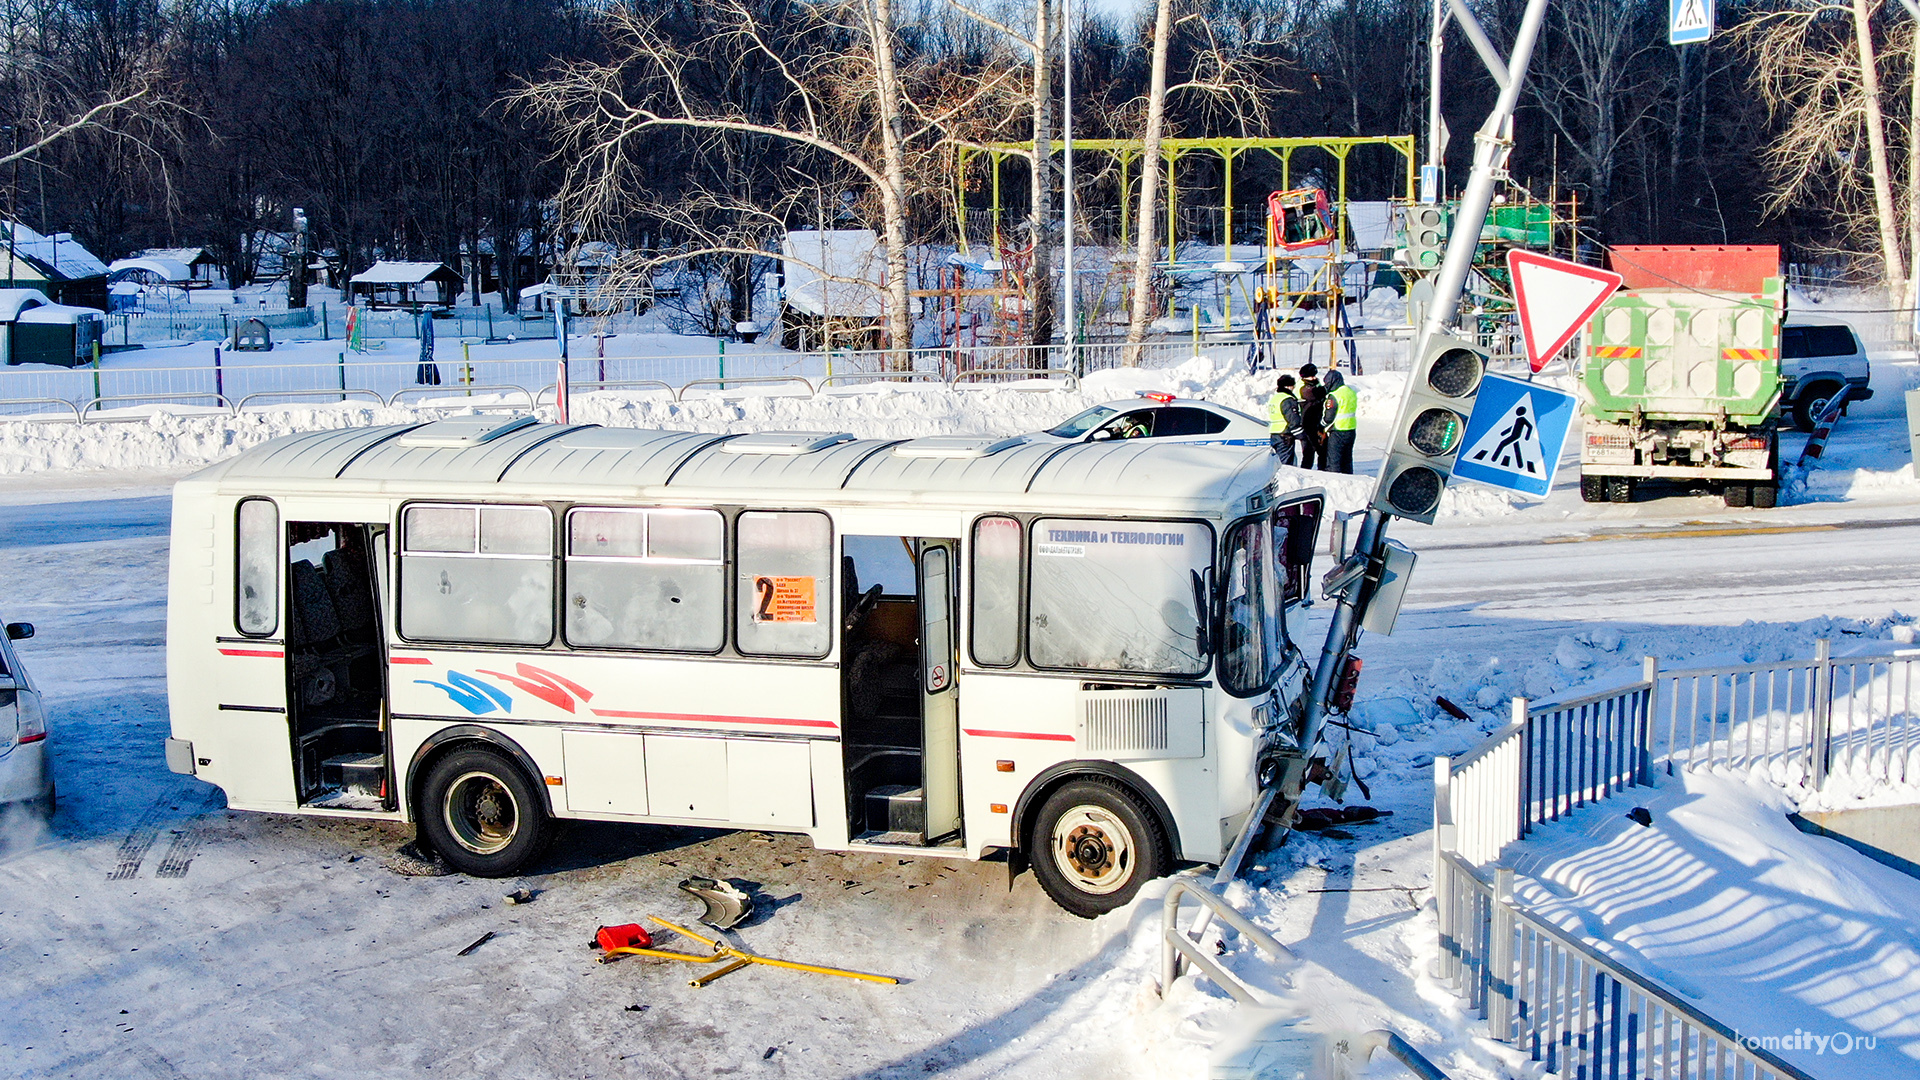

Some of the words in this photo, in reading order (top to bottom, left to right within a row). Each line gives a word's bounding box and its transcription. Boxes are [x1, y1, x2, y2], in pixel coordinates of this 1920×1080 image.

[1048, 529, 1098, 544] ТЕХНИКА
[1100, 533, 1108, 543] и
[1111, 531, 1184, 546] ТЕХНОЛОГИИ
[756, 577, 774, 621] 2
